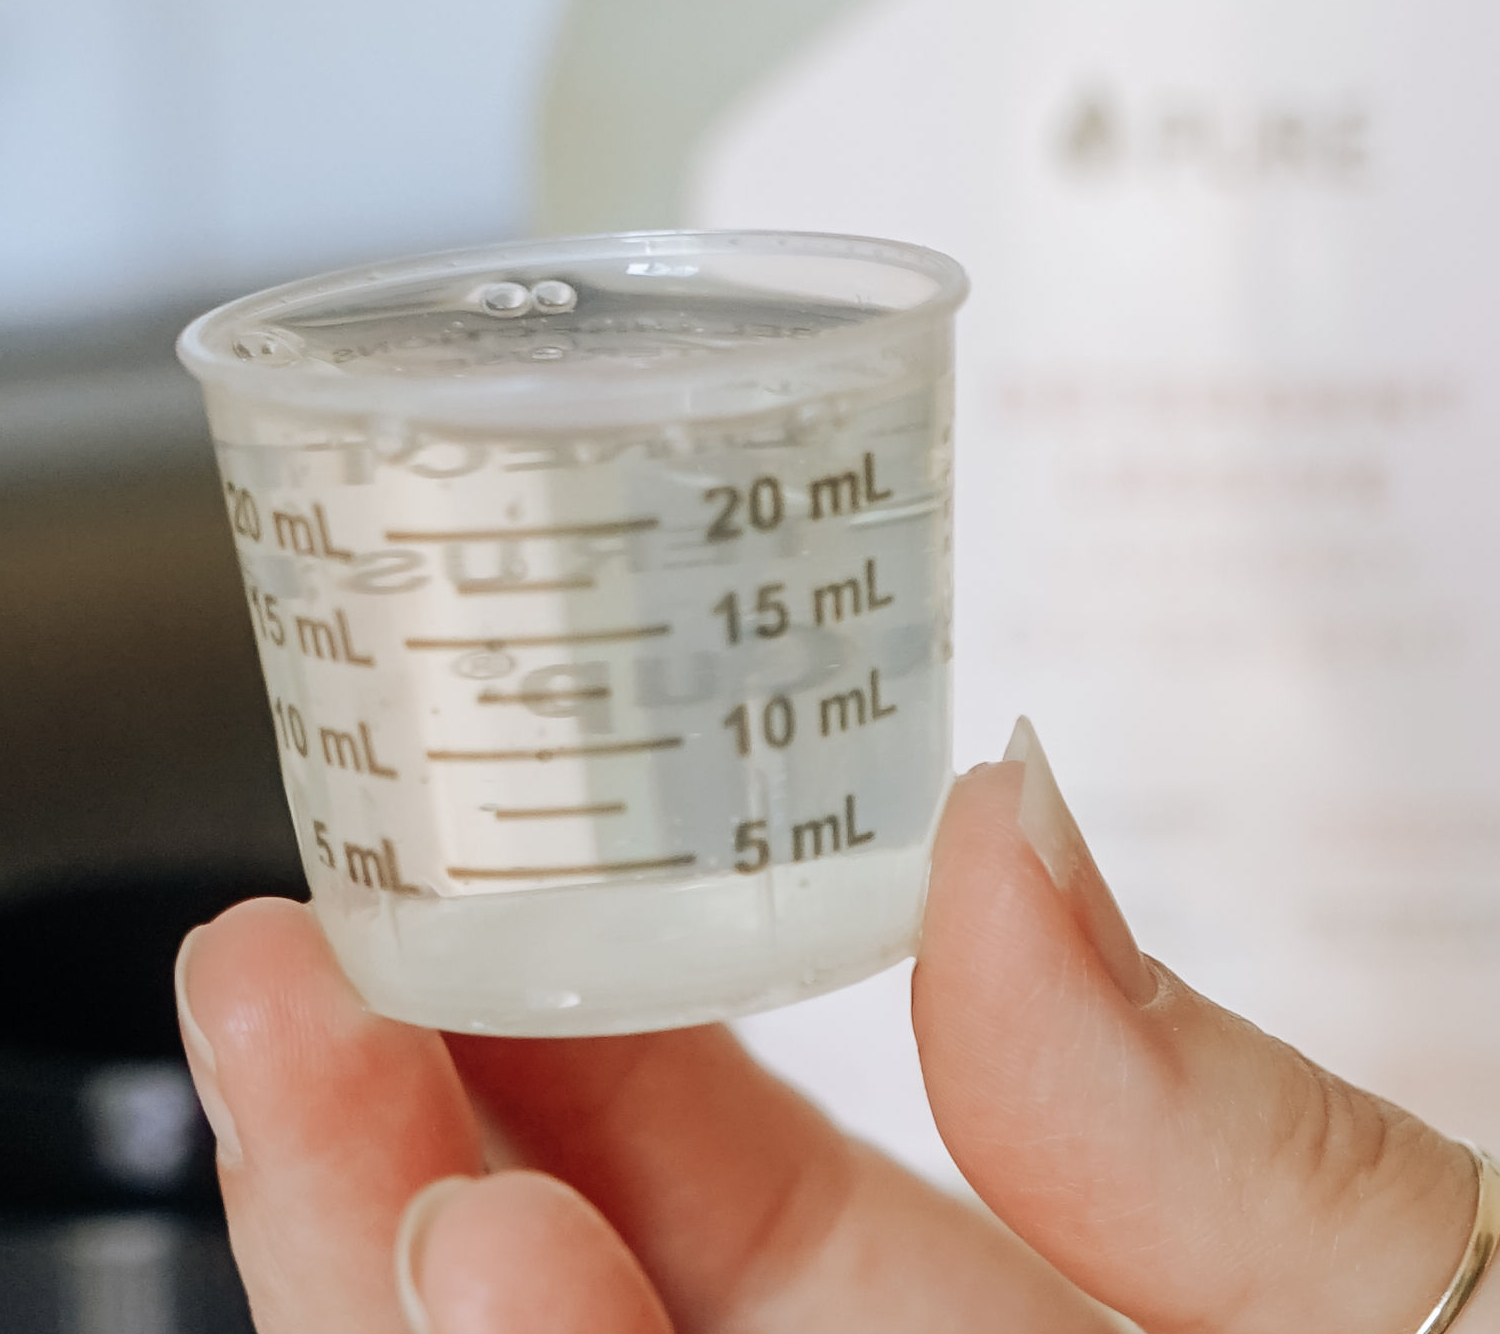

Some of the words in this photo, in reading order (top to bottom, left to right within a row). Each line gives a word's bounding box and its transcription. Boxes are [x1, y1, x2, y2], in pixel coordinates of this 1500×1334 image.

[271, 501, 356, 563] mL
[703, 473, 785, 545] 20
[808, 451, 894, 522] mL
[251, 584, 285, 647] 15
[295, 608, 378, 669] mL
[711, 581, 789, 647] 15
[812, 557, 895, 628] mL
[274, 696, 309, 759] 10
[318, 720, 399, 780] mL
[722, 692, 797, 759] 10
[819, 667, 899, 738] mL
[312, 818, 336, 871] 5
[343, 836, 422, 897] mL
[733, 819, 773, 876] 5
[791, 793, 877, 863] mL
